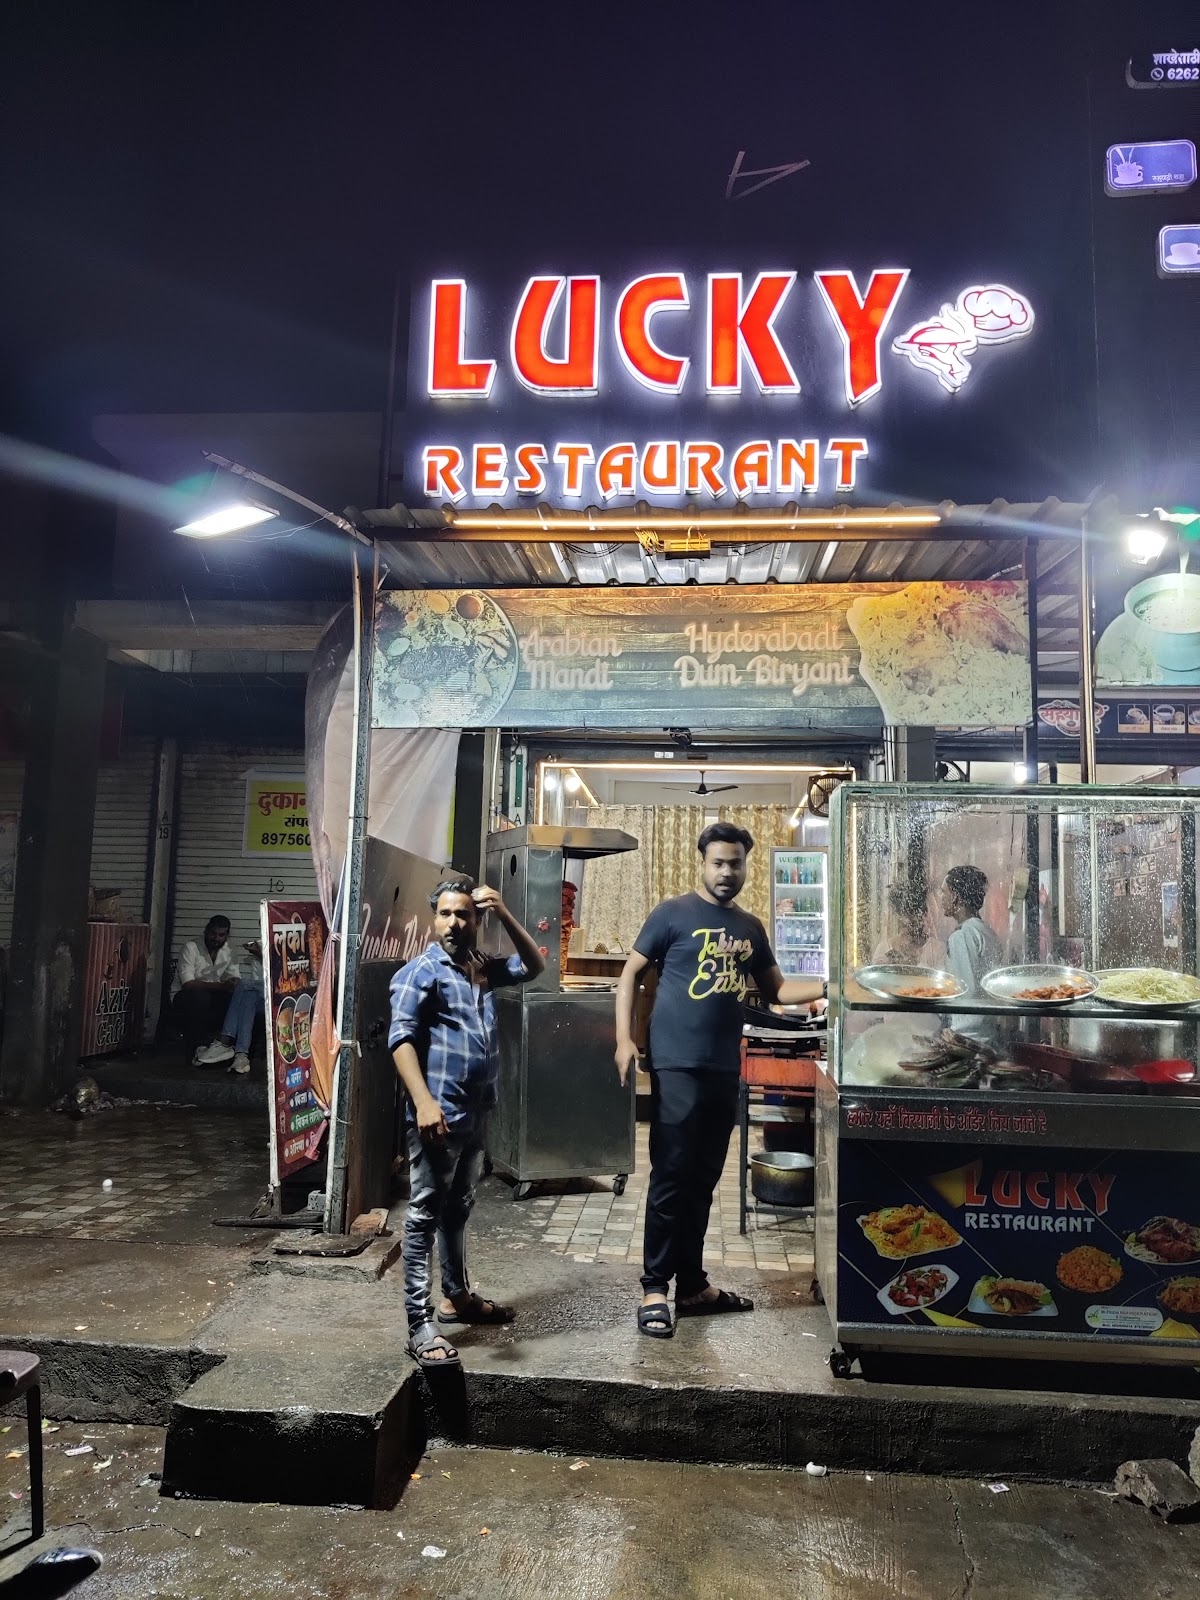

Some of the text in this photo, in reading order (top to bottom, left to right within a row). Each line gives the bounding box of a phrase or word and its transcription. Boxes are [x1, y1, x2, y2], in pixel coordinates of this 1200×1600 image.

[1167, 67, 1199, 80] 6262
[427, 268, 911, 411] LUCKY
[421, 437, 869, 502] RESTAURANT
[519, 627, 623, 662] Arabian
[683, 620, 845, 664] Hyderabadi
[527, 658, 614, 691] Mandi
[673, 653, 855, 697] Dum Biryani
[267, 877, 285, 893] 10
[691, 927, 754, 962] Taking
[688, 958, 747, 1002] Easy
[714, 953, 737, 977] It
[964, 1169, 1117, 1217] LUCKY
[964, 1211, 1096, 1234] RESTAURANT
